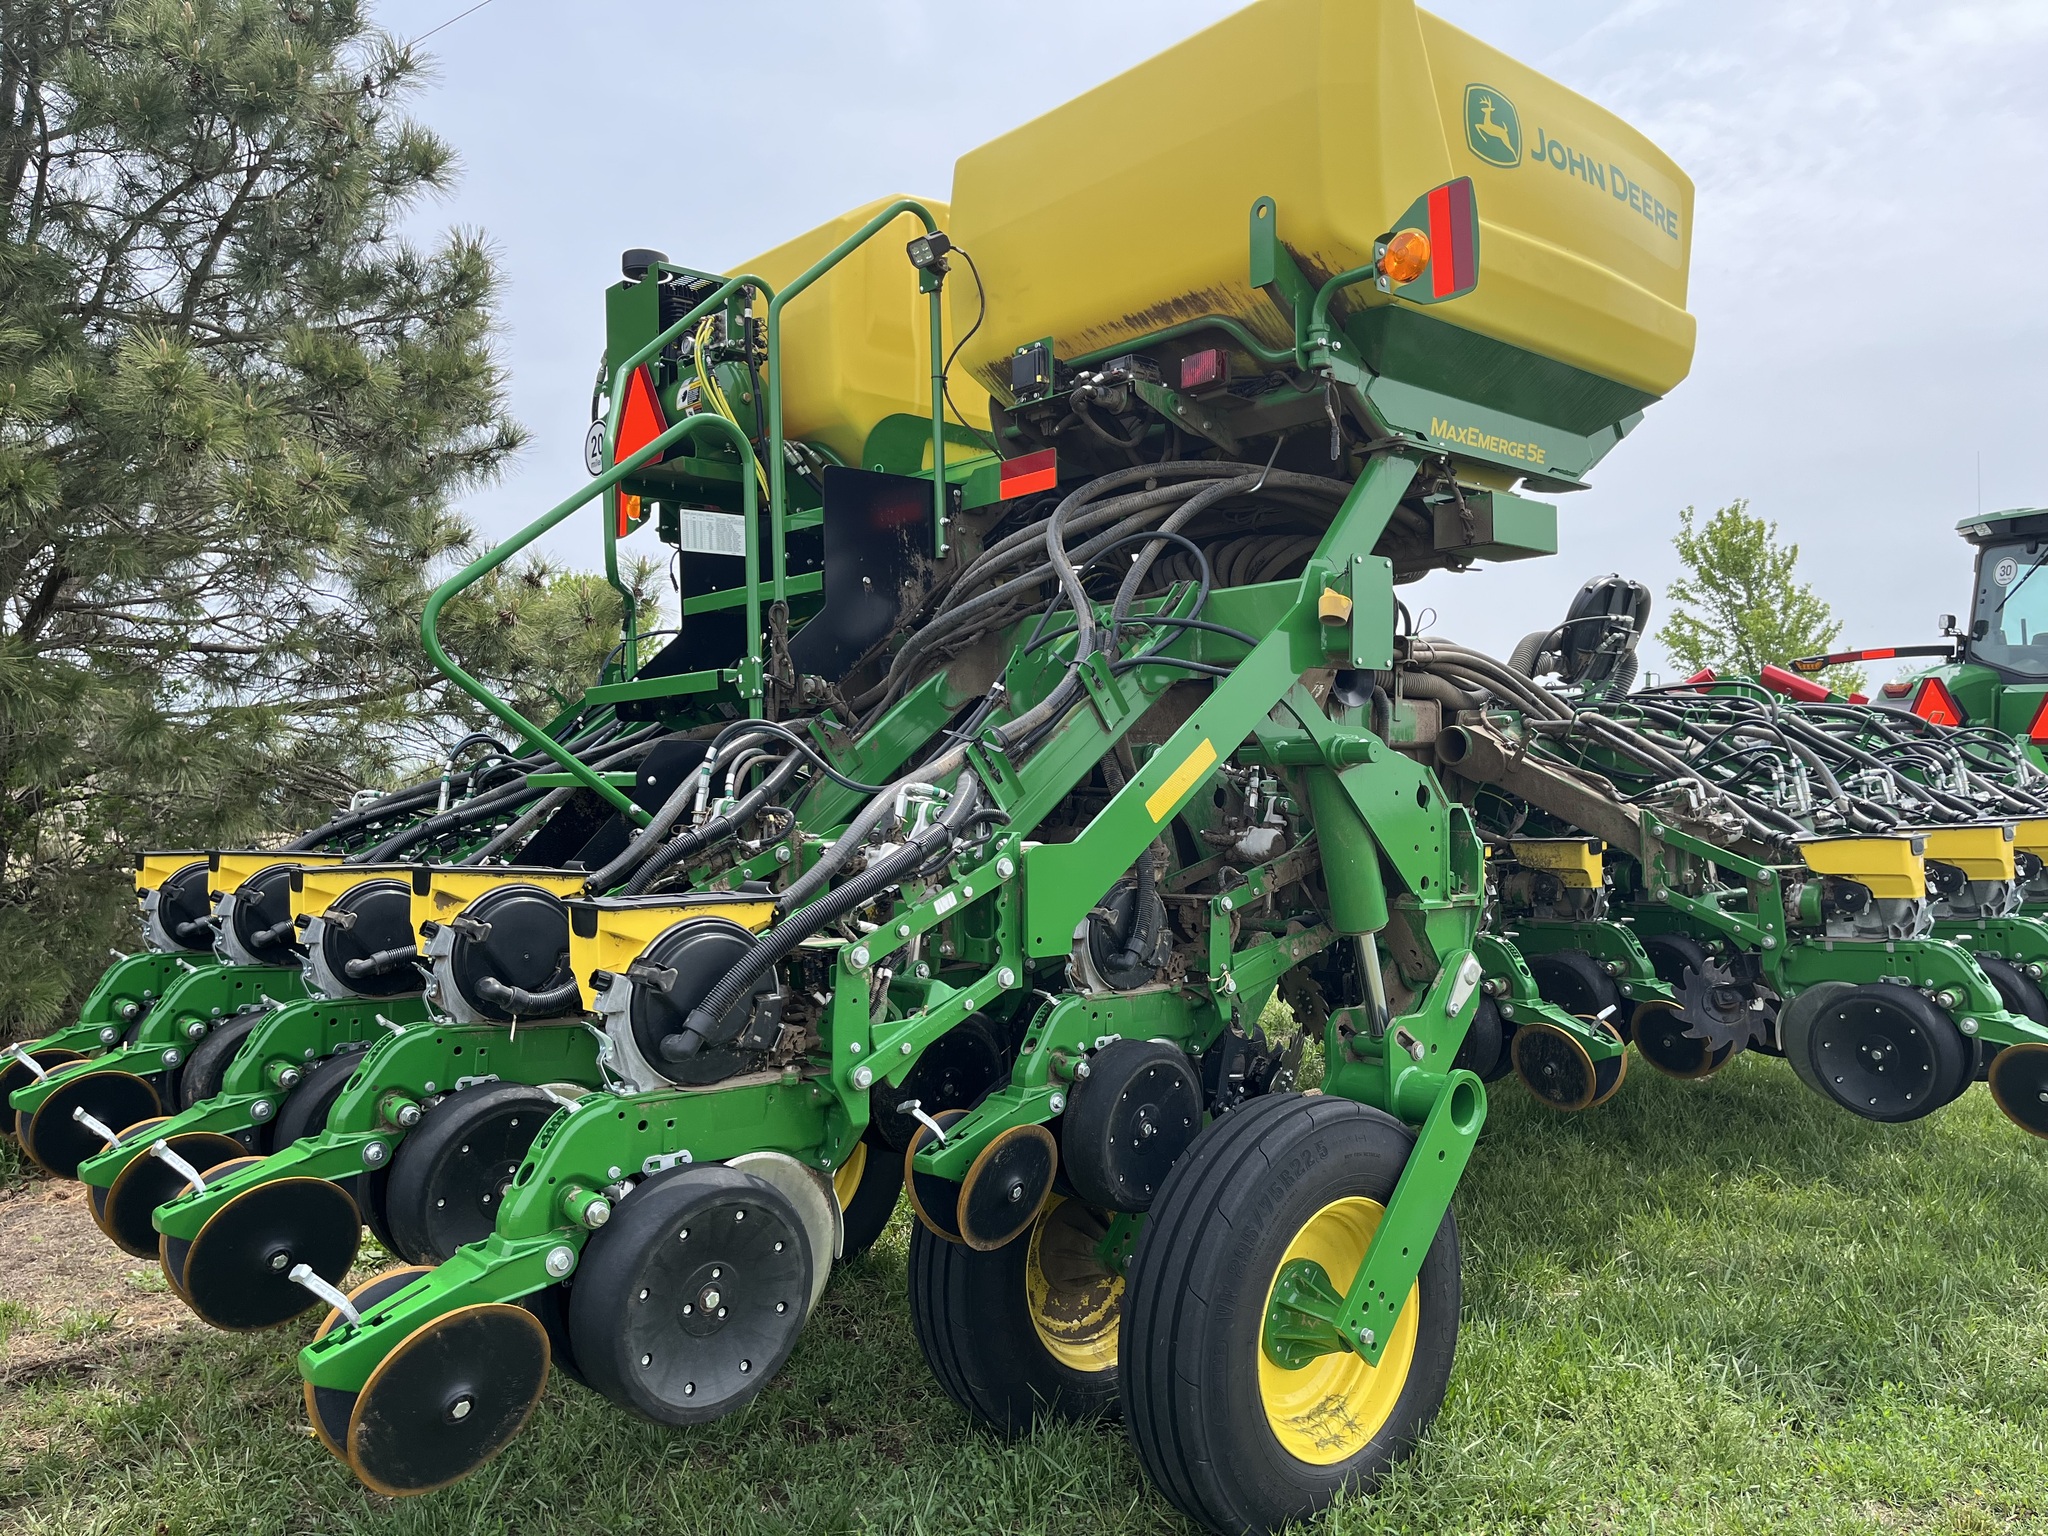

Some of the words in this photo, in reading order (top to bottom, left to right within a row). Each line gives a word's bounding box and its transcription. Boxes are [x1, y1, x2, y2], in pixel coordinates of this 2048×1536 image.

[1531, 127, 1606, 192] JOHN
[1609, 163, 1678, 241] DEERE
[591, 432, 603, 458] 20
[2000, 564, 2012, 576] 30
